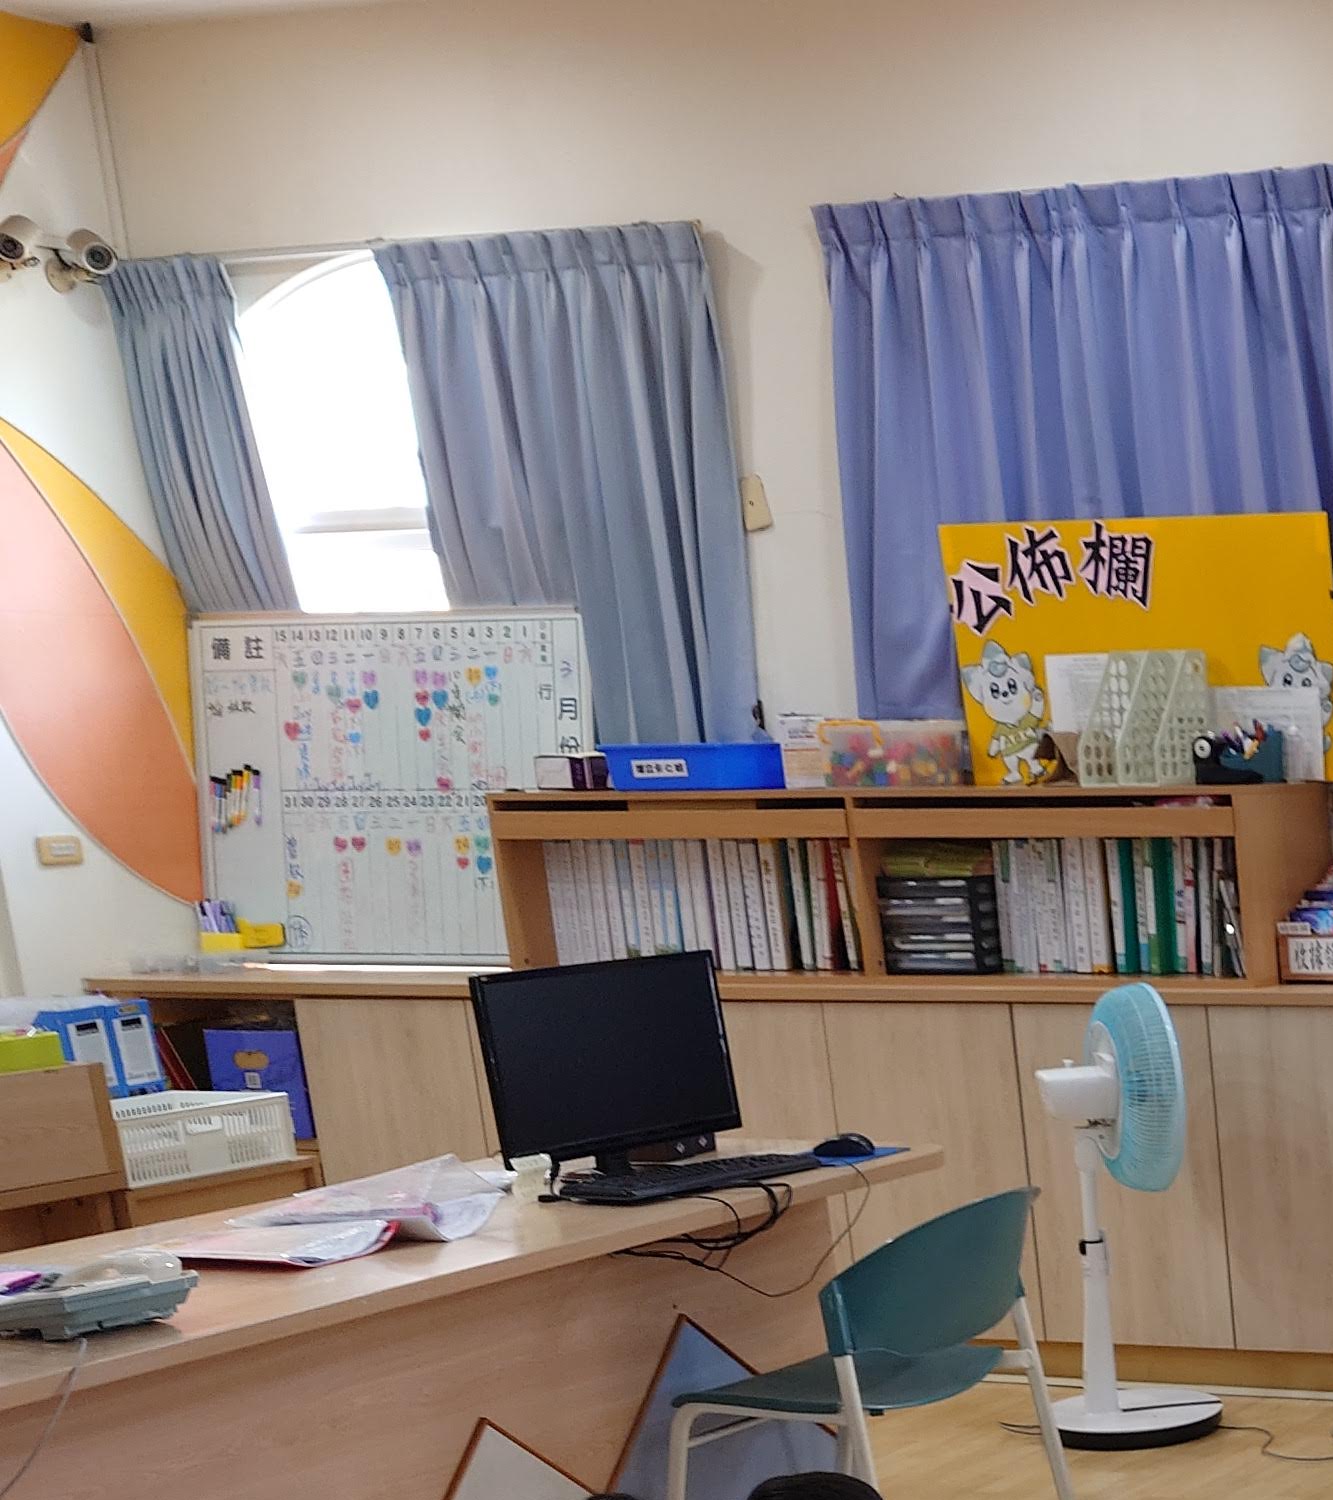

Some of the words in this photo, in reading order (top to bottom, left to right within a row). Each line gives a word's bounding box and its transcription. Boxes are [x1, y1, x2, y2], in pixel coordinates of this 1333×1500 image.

[950, 521, 1154, 635] 公佈欄
[274, 630, 288, 642] 15
[291, 629, 303, 641] 14
[308, 629, 321, 642] 13
[326, 629, 338, 641] 12
[343, 628, 355, 641] 11
[360, 628, 373, 641] 10
[380, 629, 388, 640] 9
[415, 627, 423, 639] 7
[432, 627, 441, 639] 6
[450, 627, 458, 639] 5
[467, 626, 476, 638] 4
[484, 626, 493, 639] 3
[503, 626, 512, 638] 2
[522, 625, 528, 638] 1
[211, 636, 264, 661] 備註
[284, 795, 298, 808] 31
[300, 795, 314, 808] 30
[334, 795, 348, 808] 28
[351, 795, 364, 807] 27
[368, 795, 383, 808] 26
[386, 795, 401, 808] 25
[403, 795, 417, 807] 24
[420, 795, 435, 808] 23
[437, 795, 452, 808] 22
[456, 795, 470, 807] 21
